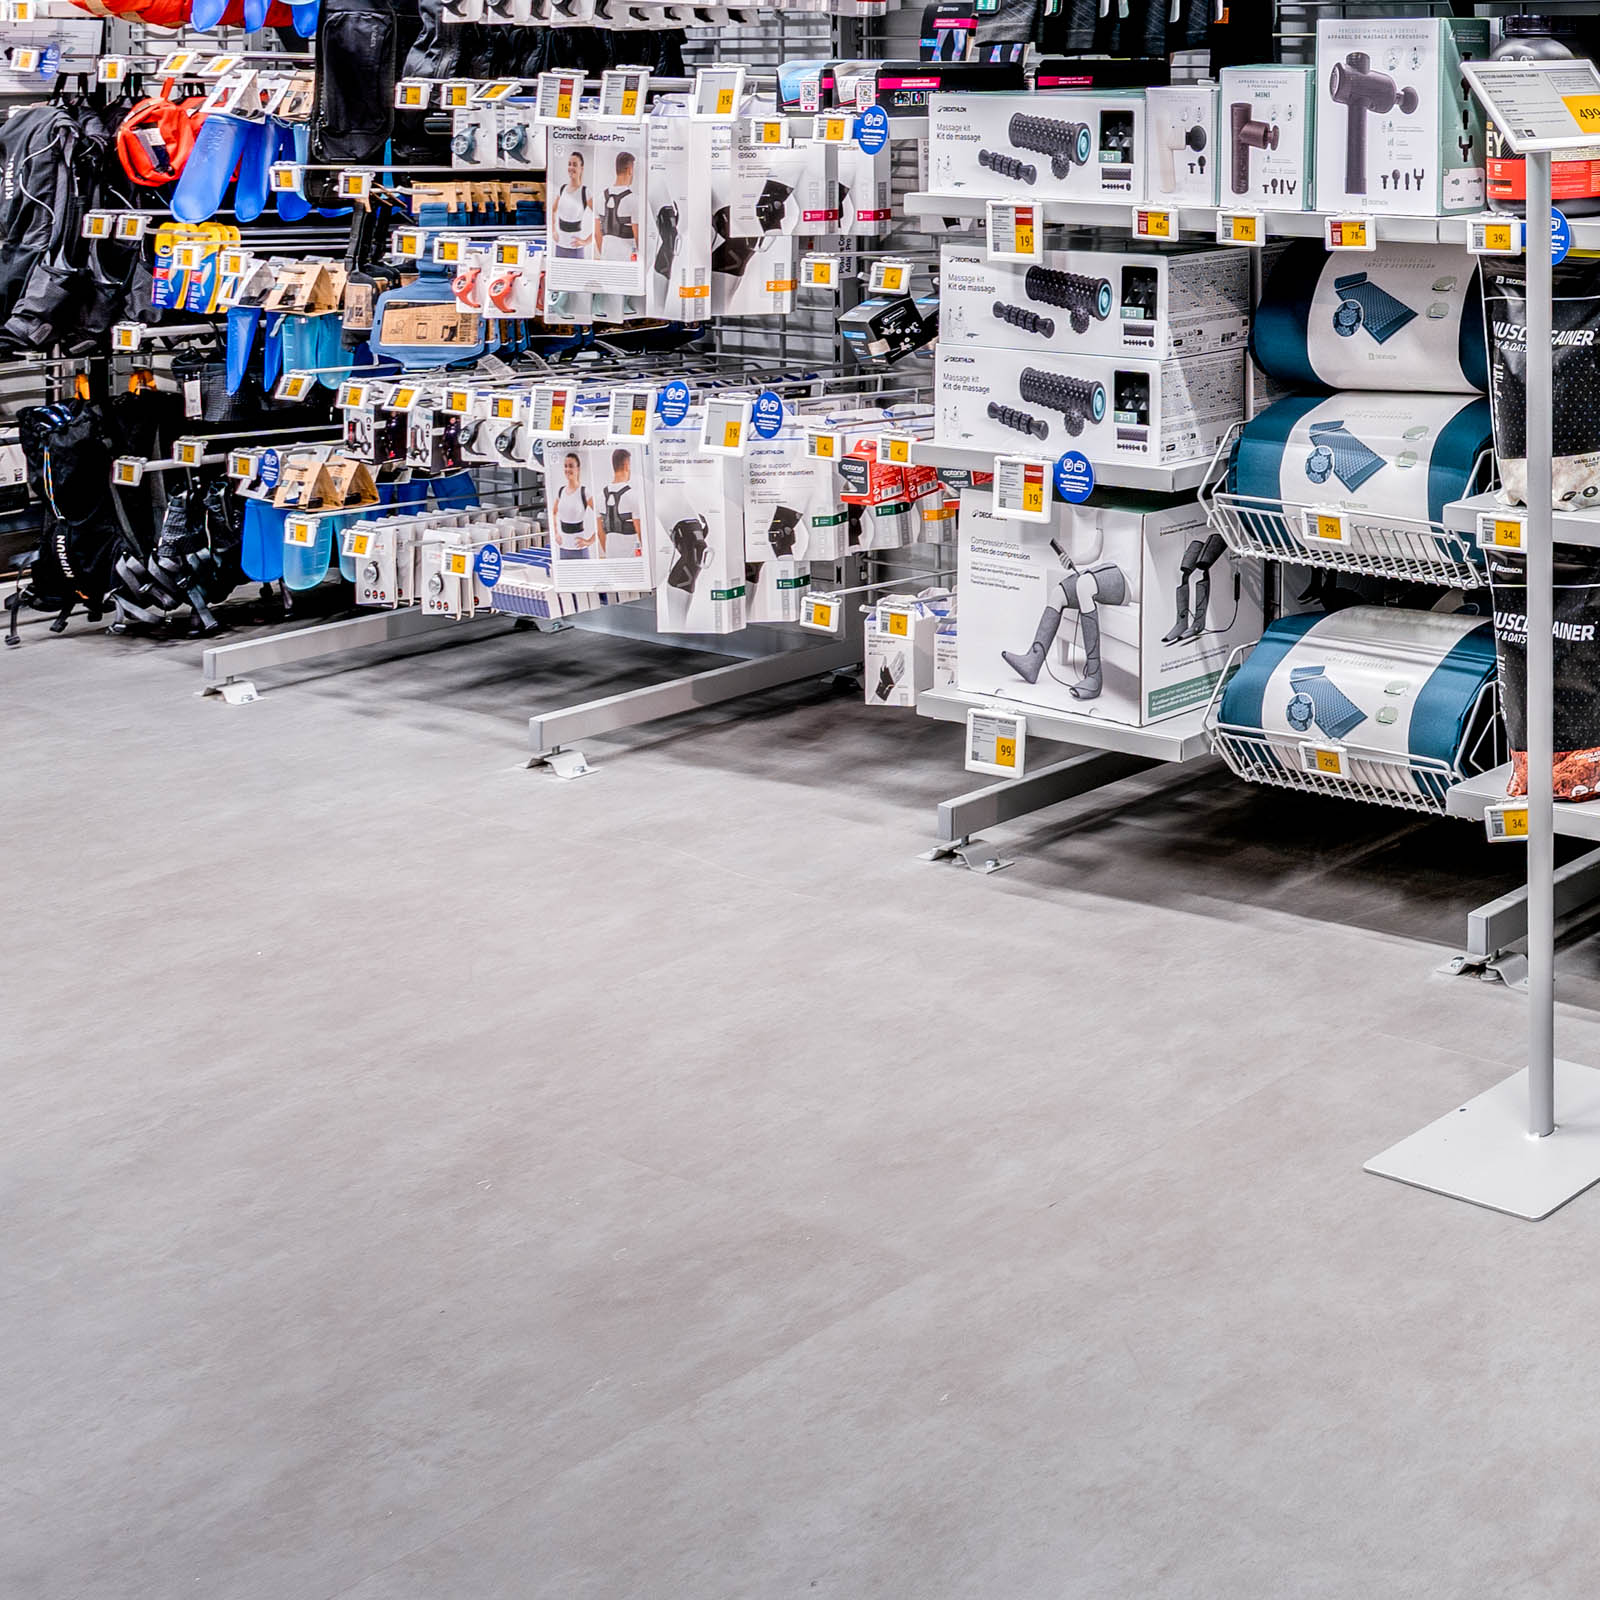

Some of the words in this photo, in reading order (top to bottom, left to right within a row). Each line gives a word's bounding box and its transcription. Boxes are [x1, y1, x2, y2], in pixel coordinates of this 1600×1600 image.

[552, 131, 586, 141] Corrector
[588, 132, 611, 143] Adapt
[612, 133, 625, 142] Pro
[955, 134, 981, 143] massage
[56, 535, 74, 578] KIPRUN
